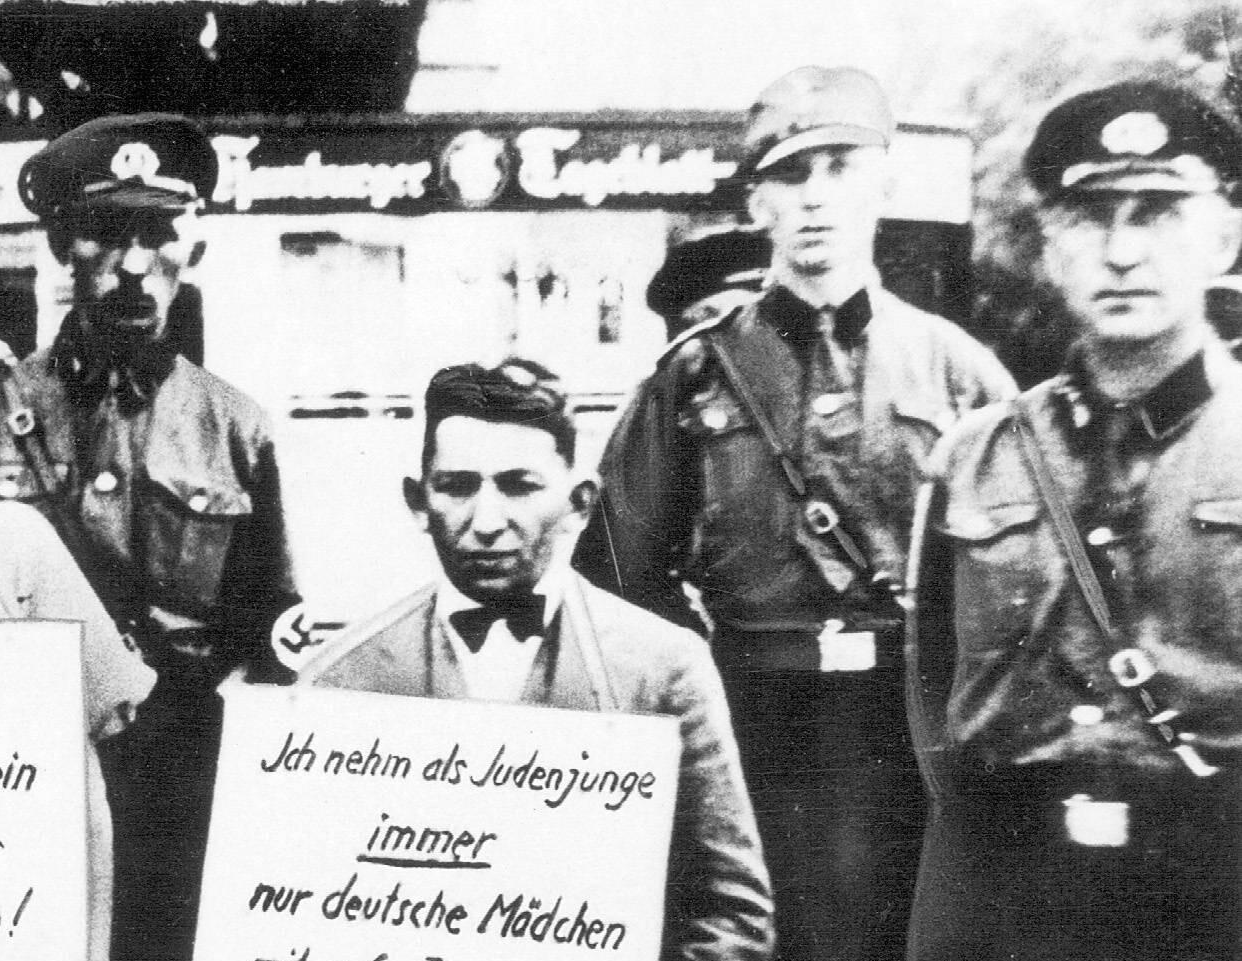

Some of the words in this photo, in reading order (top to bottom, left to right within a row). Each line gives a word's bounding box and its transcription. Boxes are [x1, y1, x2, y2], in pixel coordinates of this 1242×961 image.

[323, 738, 411, 779] nehm
[422, 743, 468, 785] als
[469, 744, 656, 811] Judenjunge
[356, 812, 497, 870] immer
[248, 882, 314, 916] nur
[321, 873, 468, 935] deutsche
[476, 893, 626, 950] Mädchen
